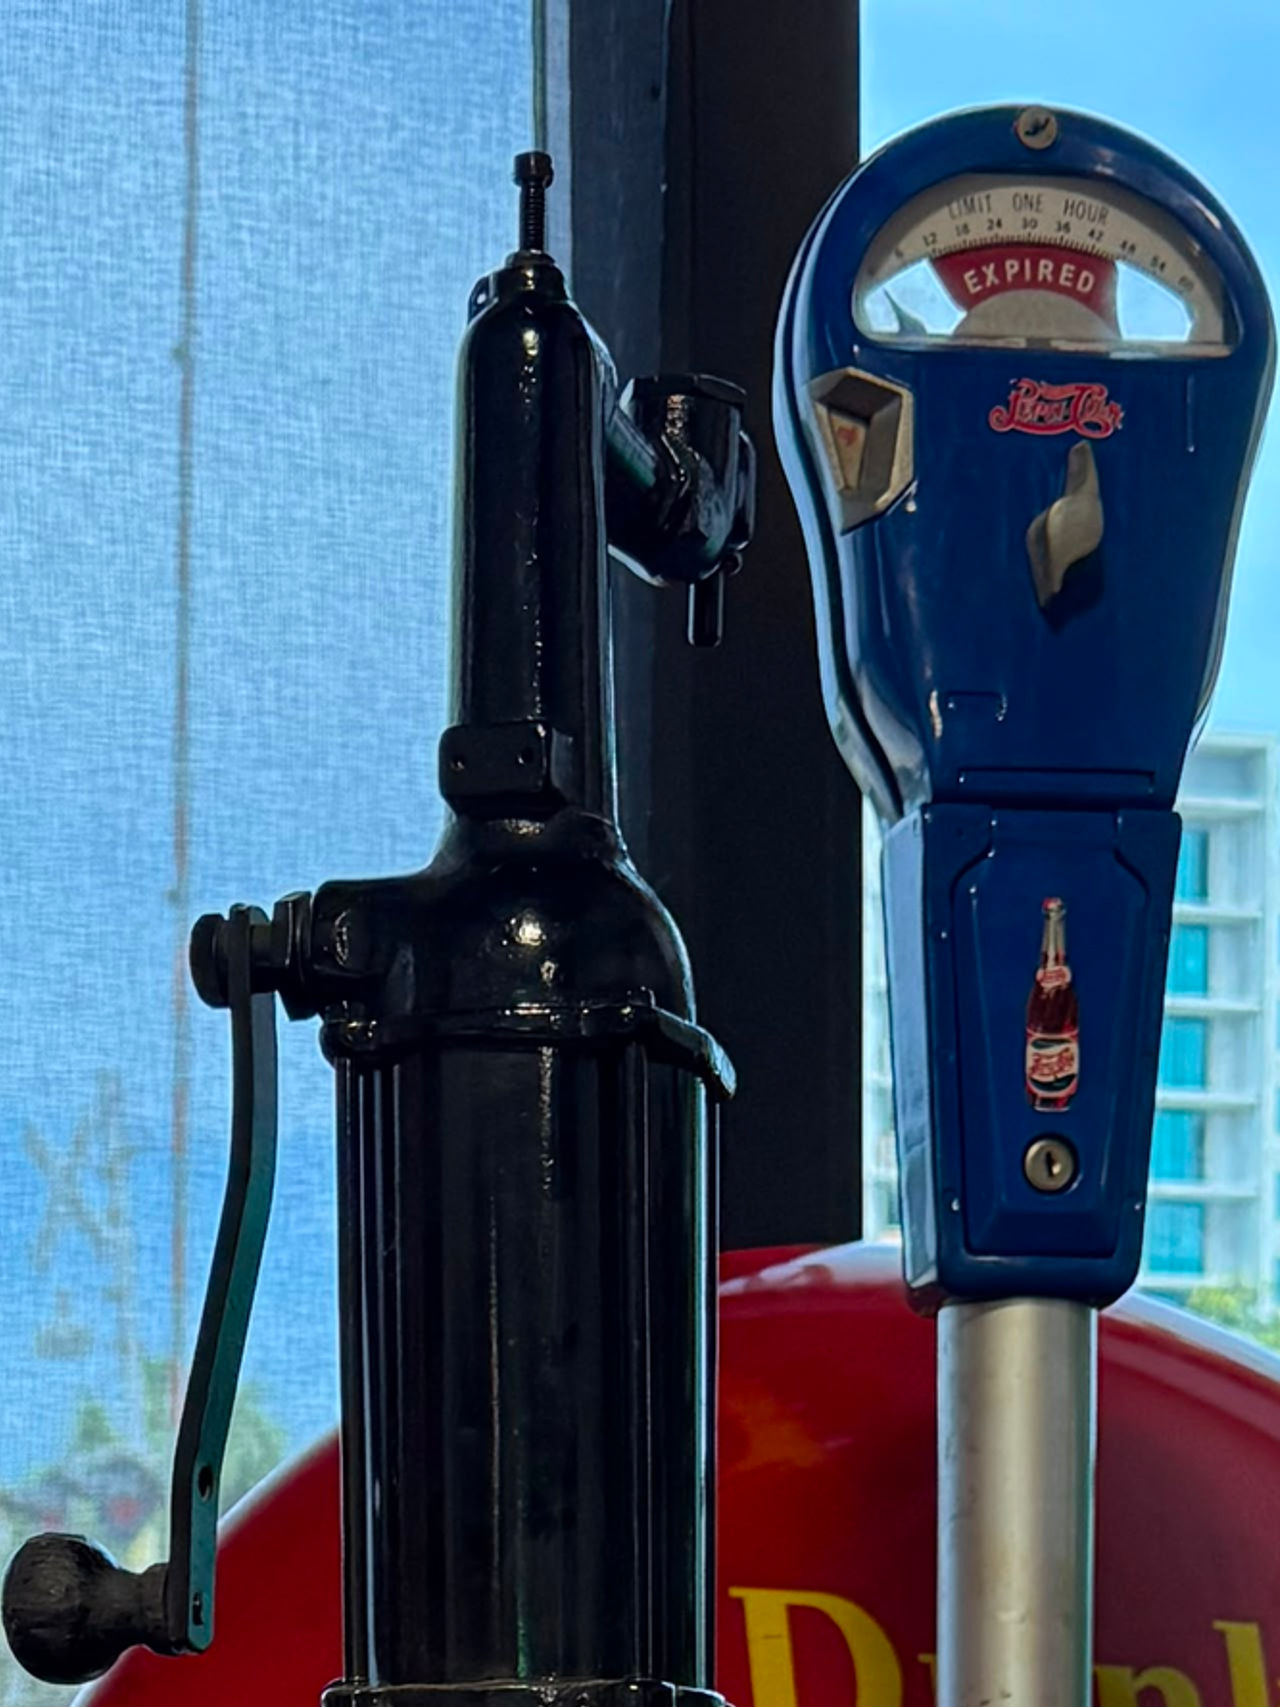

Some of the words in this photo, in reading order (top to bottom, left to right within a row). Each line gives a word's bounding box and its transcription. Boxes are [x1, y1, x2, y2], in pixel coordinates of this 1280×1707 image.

[948, 194, 993, 220] LIMIT
[1012, 192, 1045, 214] ONE
[1062, 198, 1111, 226] HOUR
[922, 232, 938, 247] 12
[986, 217, 1003, 231] 24
[1021, 216, 1039, 230] 30
[1055, 220, 1072, 234] 36
[1087, 228, 1105, 242] 42
[962, 257, 1096, 295] EXPIRED
